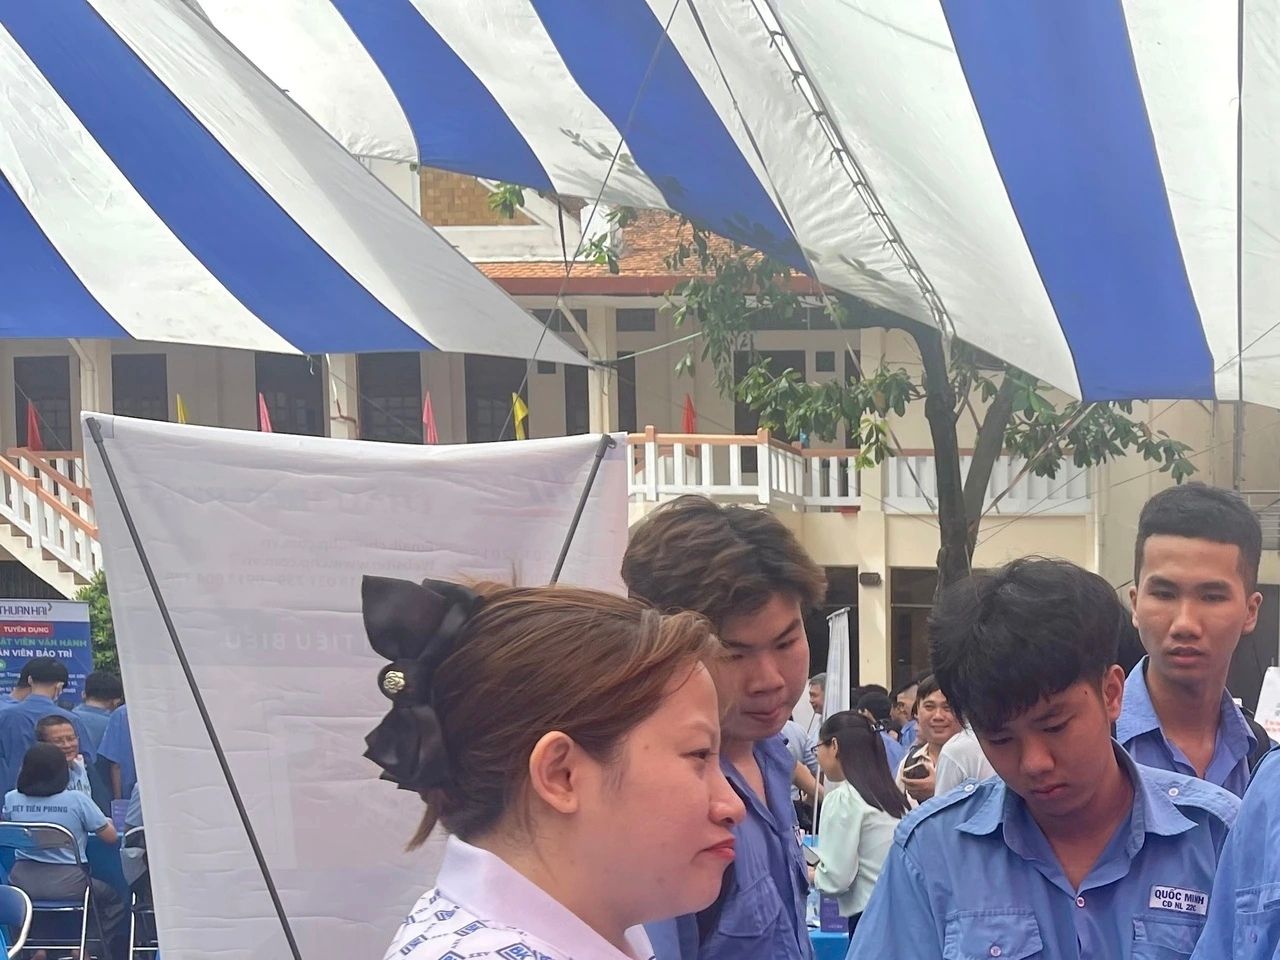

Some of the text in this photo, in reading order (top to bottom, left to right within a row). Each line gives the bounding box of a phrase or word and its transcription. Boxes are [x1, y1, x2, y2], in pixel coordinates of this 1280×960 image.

[12, 648, 33, 657] VIÊN
[36, 647, 56, 658] BẢO
[58, 648, 73, 658] TRÌ
[1154, 888, 1182, 901] QUỐC
[1174, 902, 1184, 910] NL
